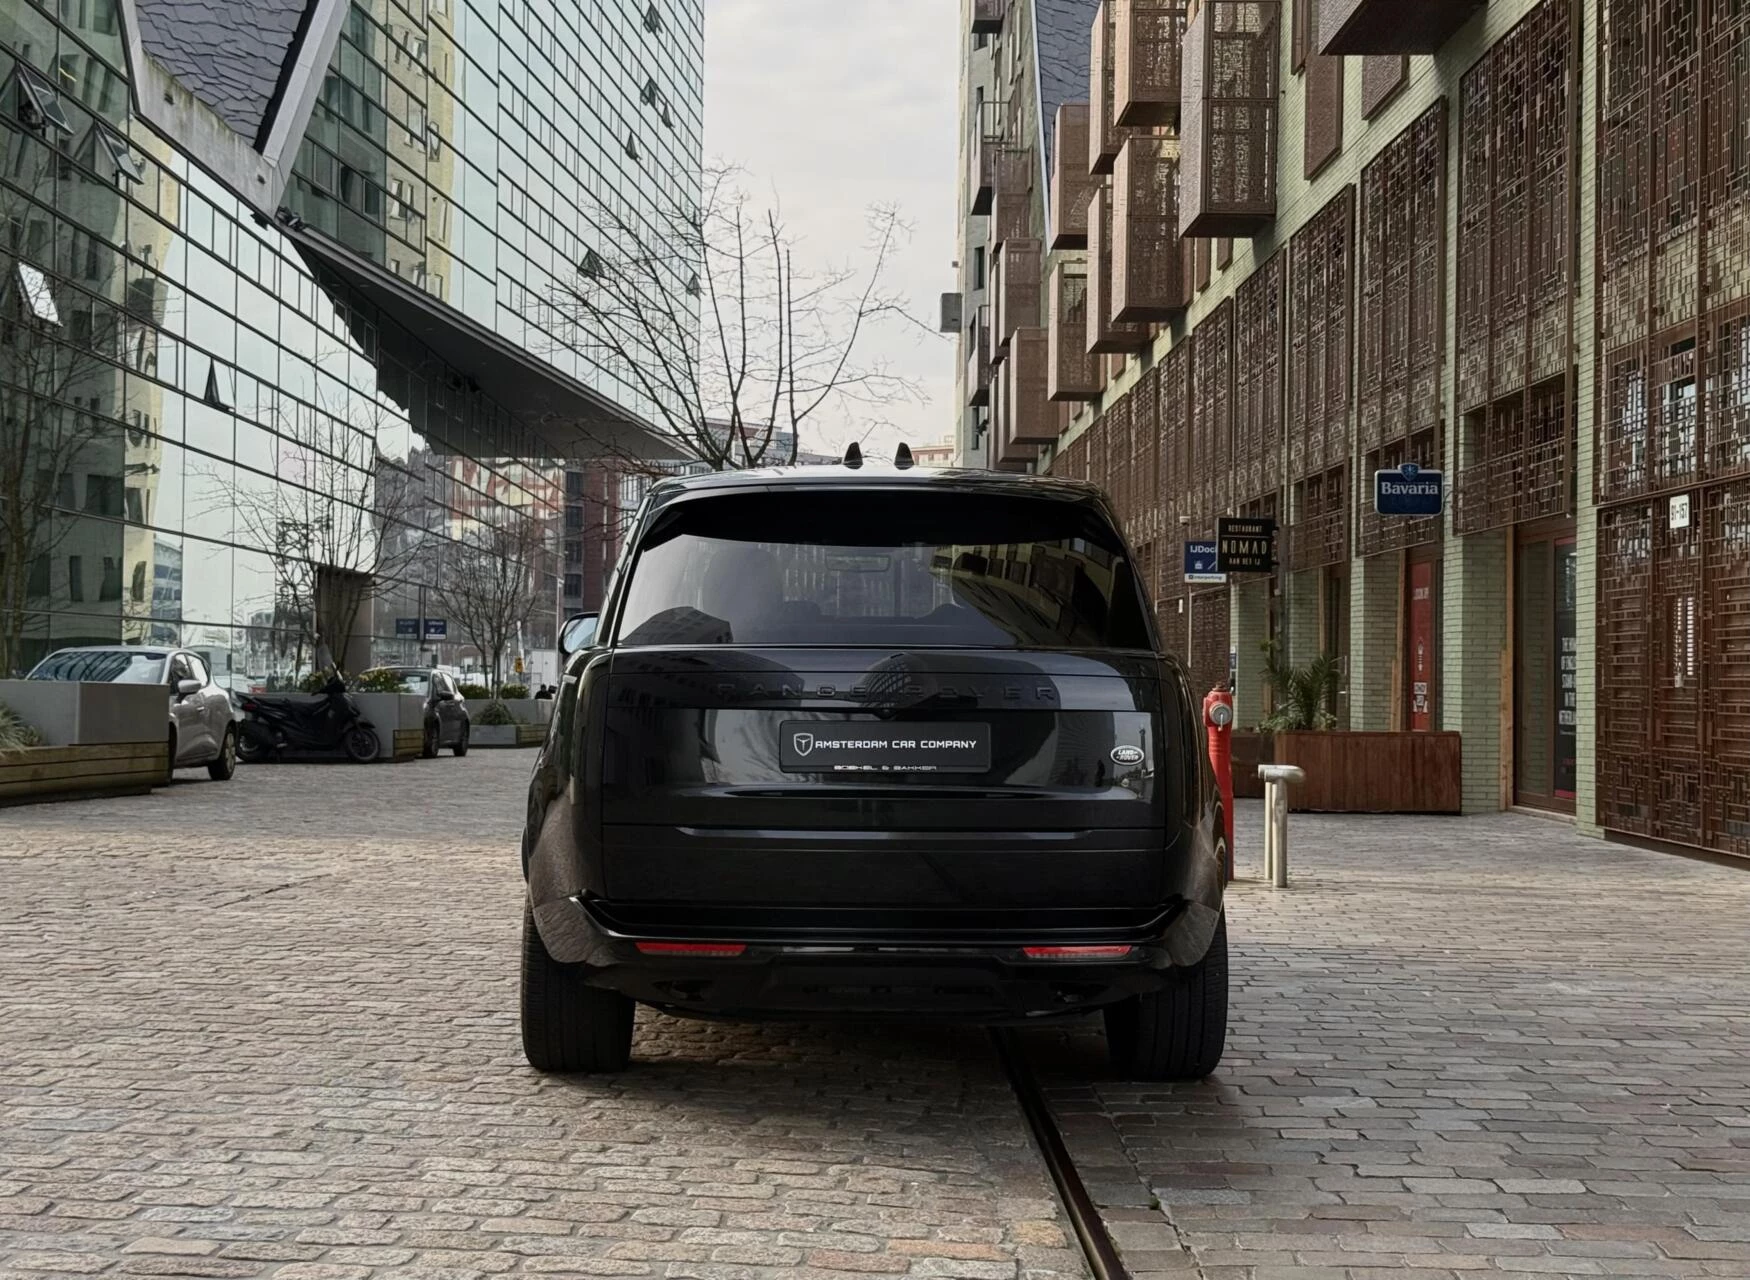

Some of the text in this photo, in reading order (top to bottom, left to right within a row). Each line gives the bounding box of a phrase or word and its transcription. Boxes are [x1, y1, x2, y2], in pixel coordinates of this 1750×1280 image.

[1381, 481, 1439, 495] Bavaria
[1222, 540, 1267, 554] NOMAD
[815, 740, 977, 749] AMSTERDAM CAR COMPANY
